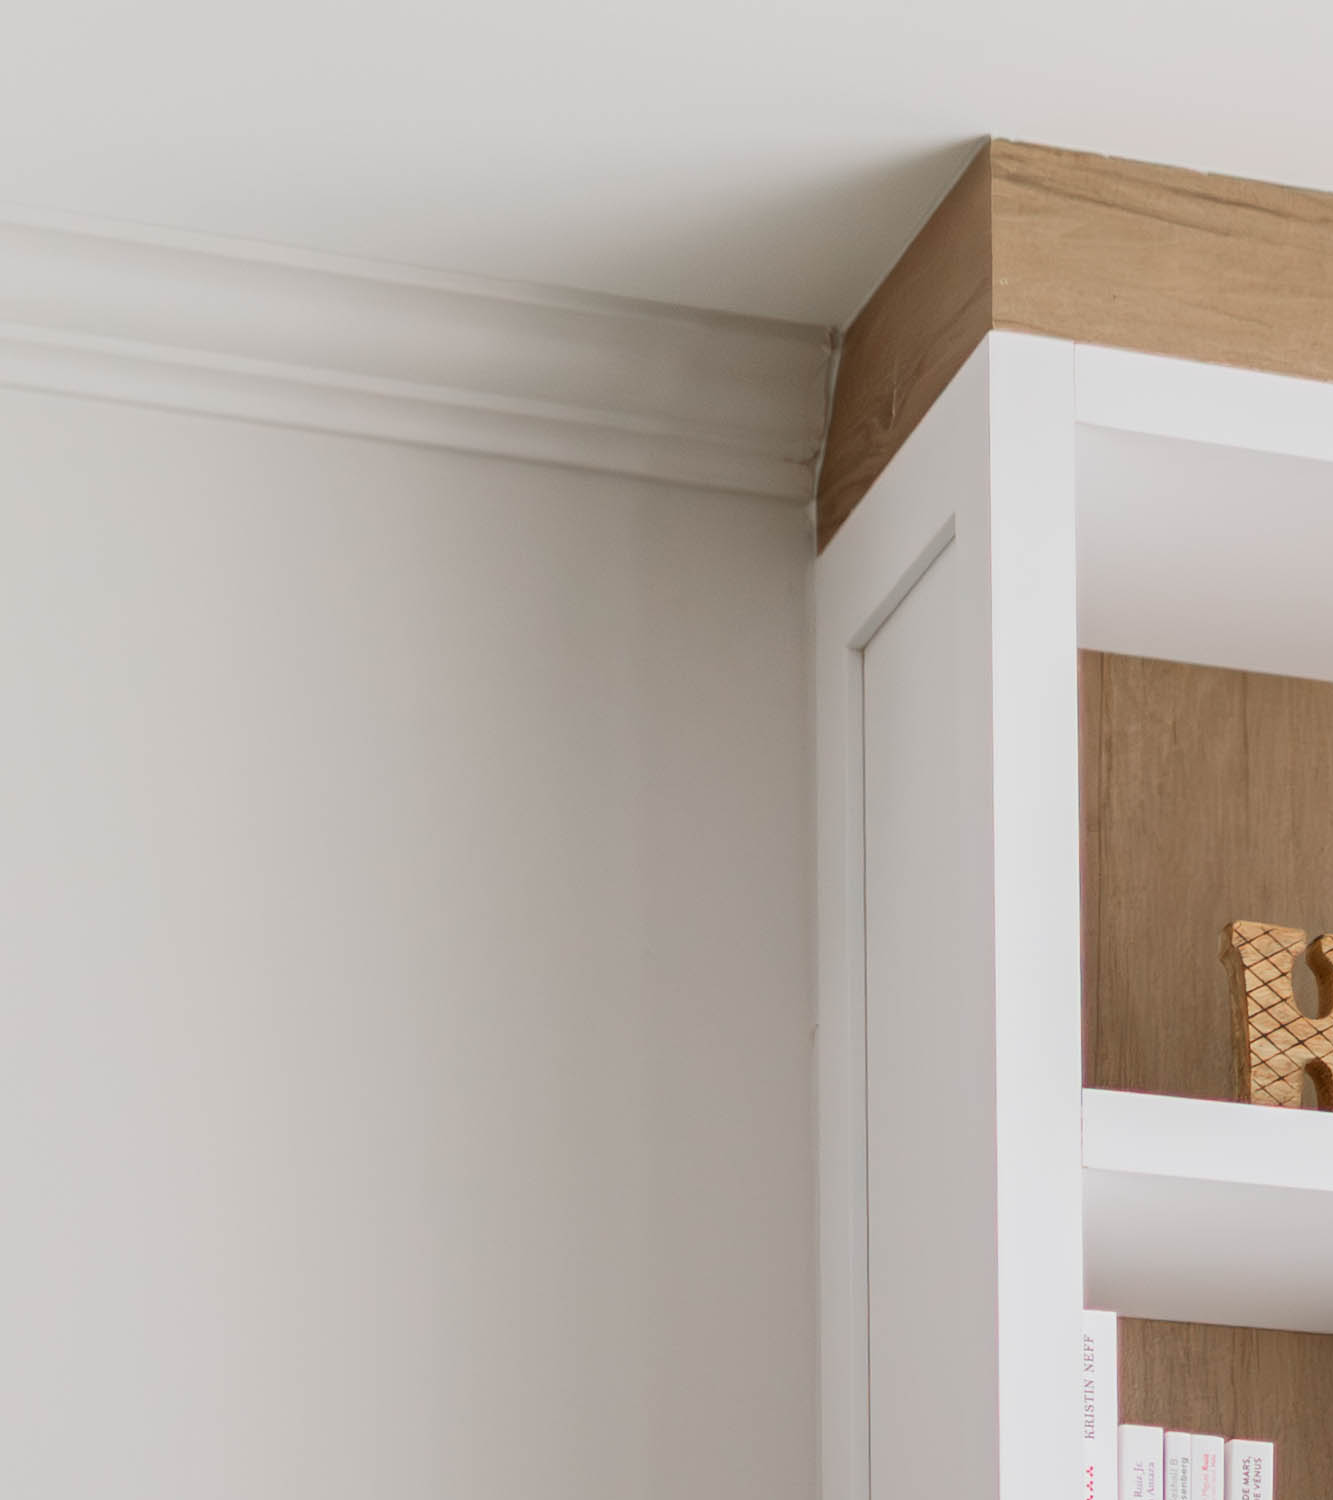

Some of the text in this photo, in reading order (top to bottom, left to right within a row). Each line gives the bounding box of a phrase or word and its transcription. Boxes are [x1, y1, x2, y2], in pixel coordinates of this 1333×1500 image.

[1083, 1333, 1096, 1440] KRISTIN NEFF
[1241, 1487, 1250, 1500] DE
